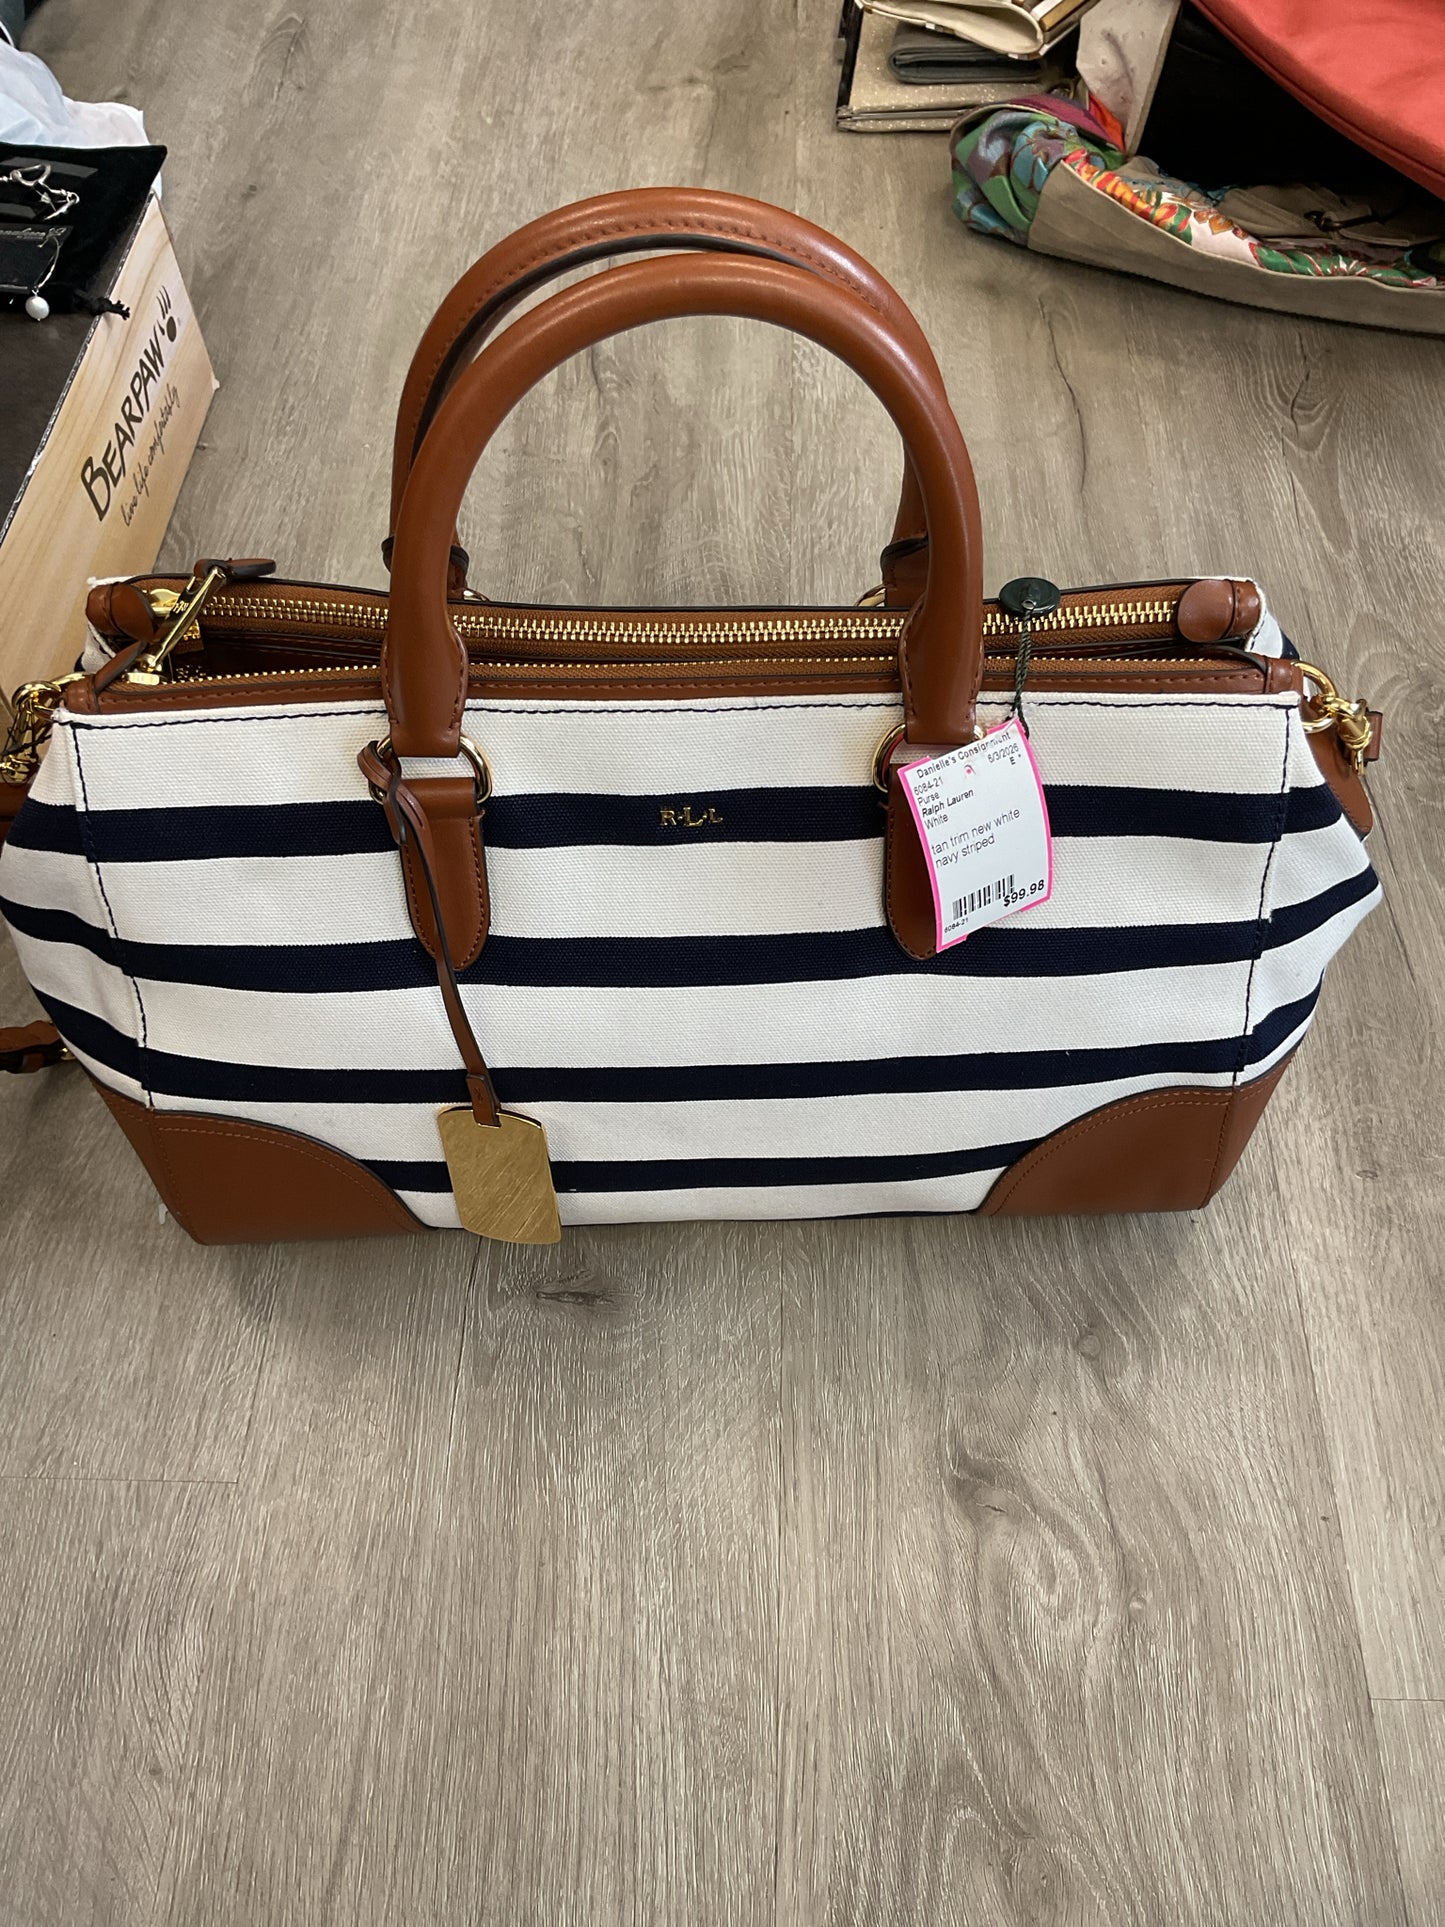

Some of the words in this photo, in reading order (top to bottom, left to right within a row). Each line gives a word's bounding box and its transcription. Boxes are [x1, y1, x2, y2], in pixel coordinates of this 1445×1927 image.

[80, 325, 165, 522] BEARPAW
[133, 462, 150, 497] life
[916, 755, 957, 779] Danielle's
[913, 776, 944, 796] 6084-21
[917, 792, 940, 807] Purse
[921, 801, 945, 818] Ralph
[946, 789, 974, 807] Lauren
[924, 813, 949, 830] White
[931, 841, 949, 855] tan
[950, 831, 970, 847] trim
[971, 821, 992, 838] new
[993, 808, 1020, 828] white
[935, 851, 959, 869] navy
[961, 833, 995, 857] striped
[1003, 879, 1045, 907] $99.98
[944, 917, 969, 933] 6084-21
